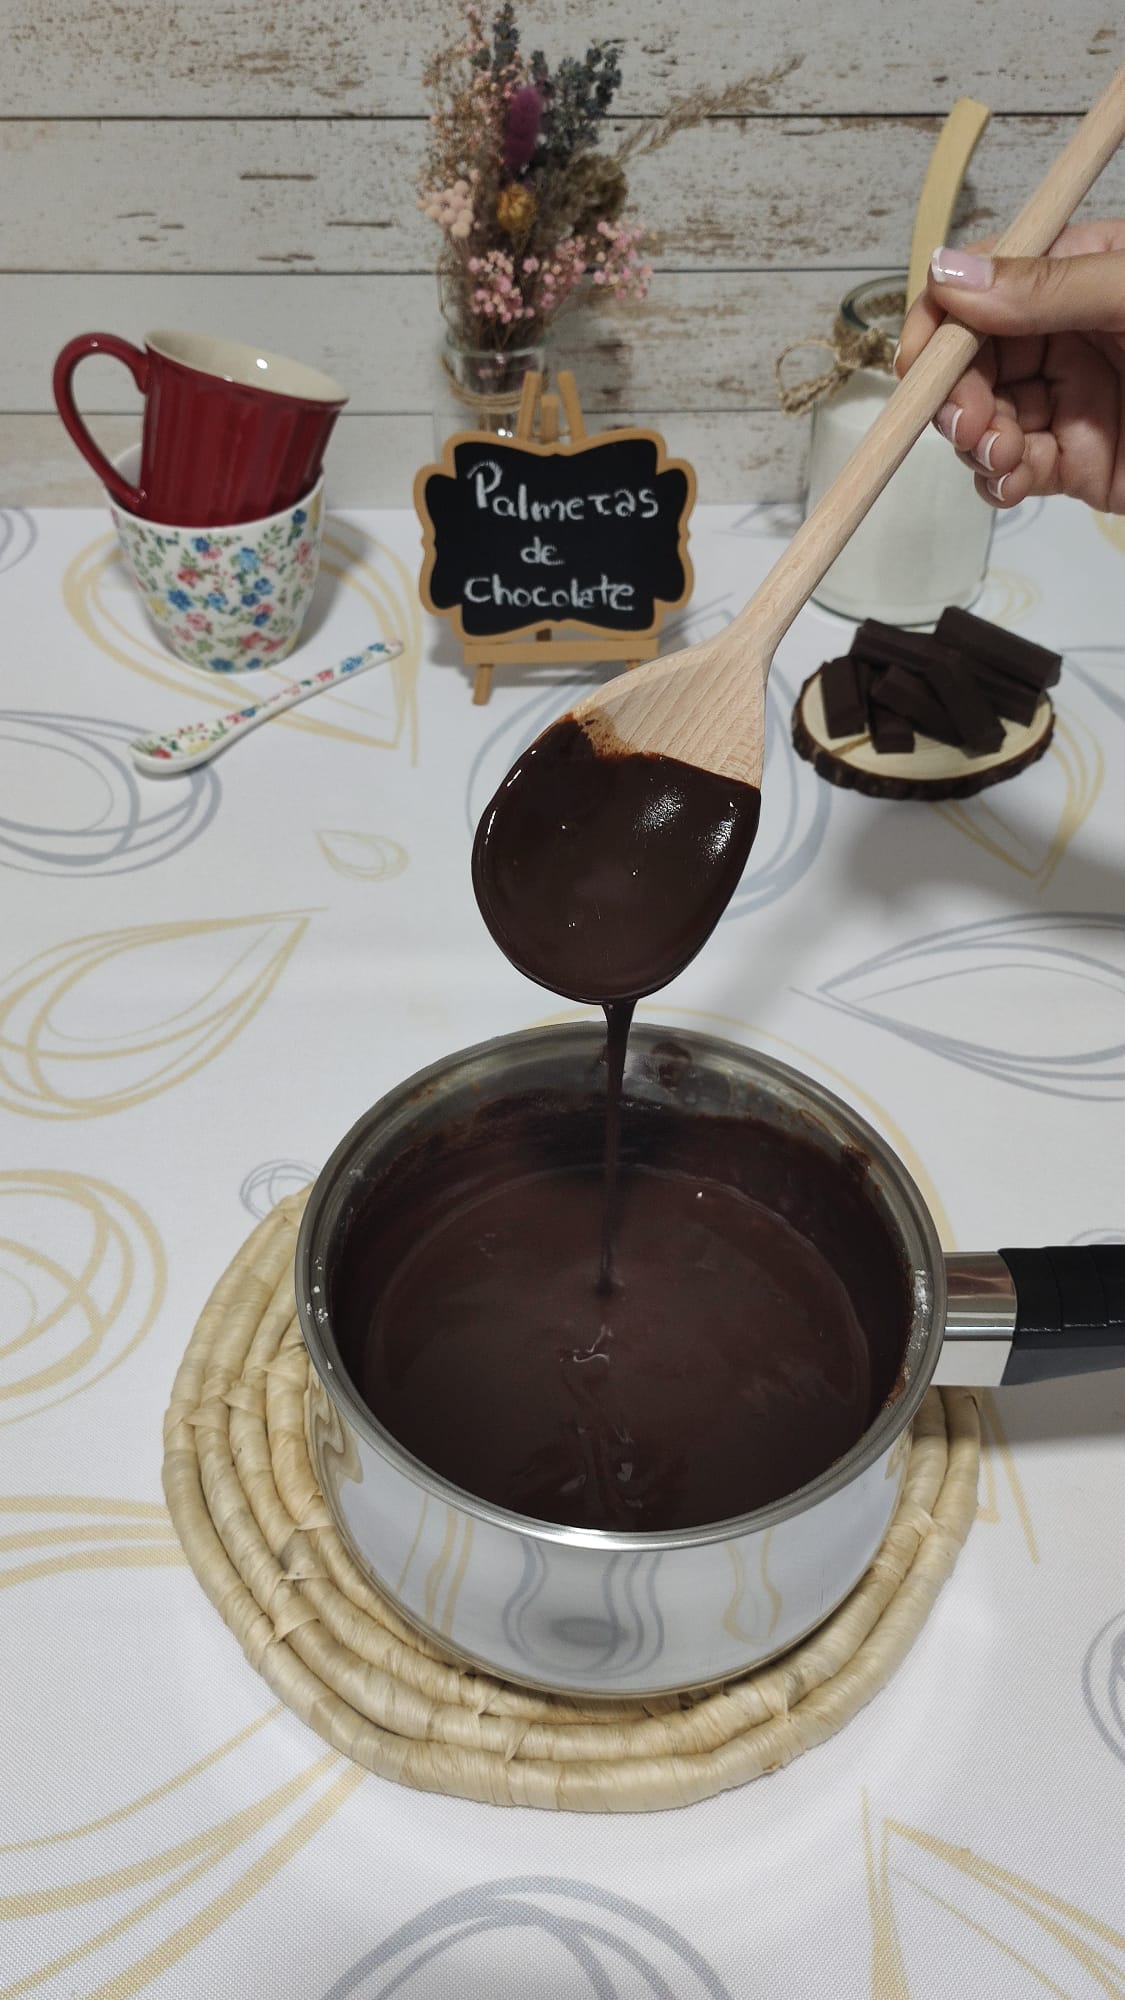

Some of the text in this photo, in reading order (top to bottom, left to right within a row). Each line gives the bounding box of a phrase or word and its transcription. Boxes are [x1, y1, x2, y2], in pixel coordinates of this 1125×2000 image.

[466, 460, 659, 522] Palmetas
[520, 536, 564, 566] de
[464, 573, 635, 611] Chocolate
